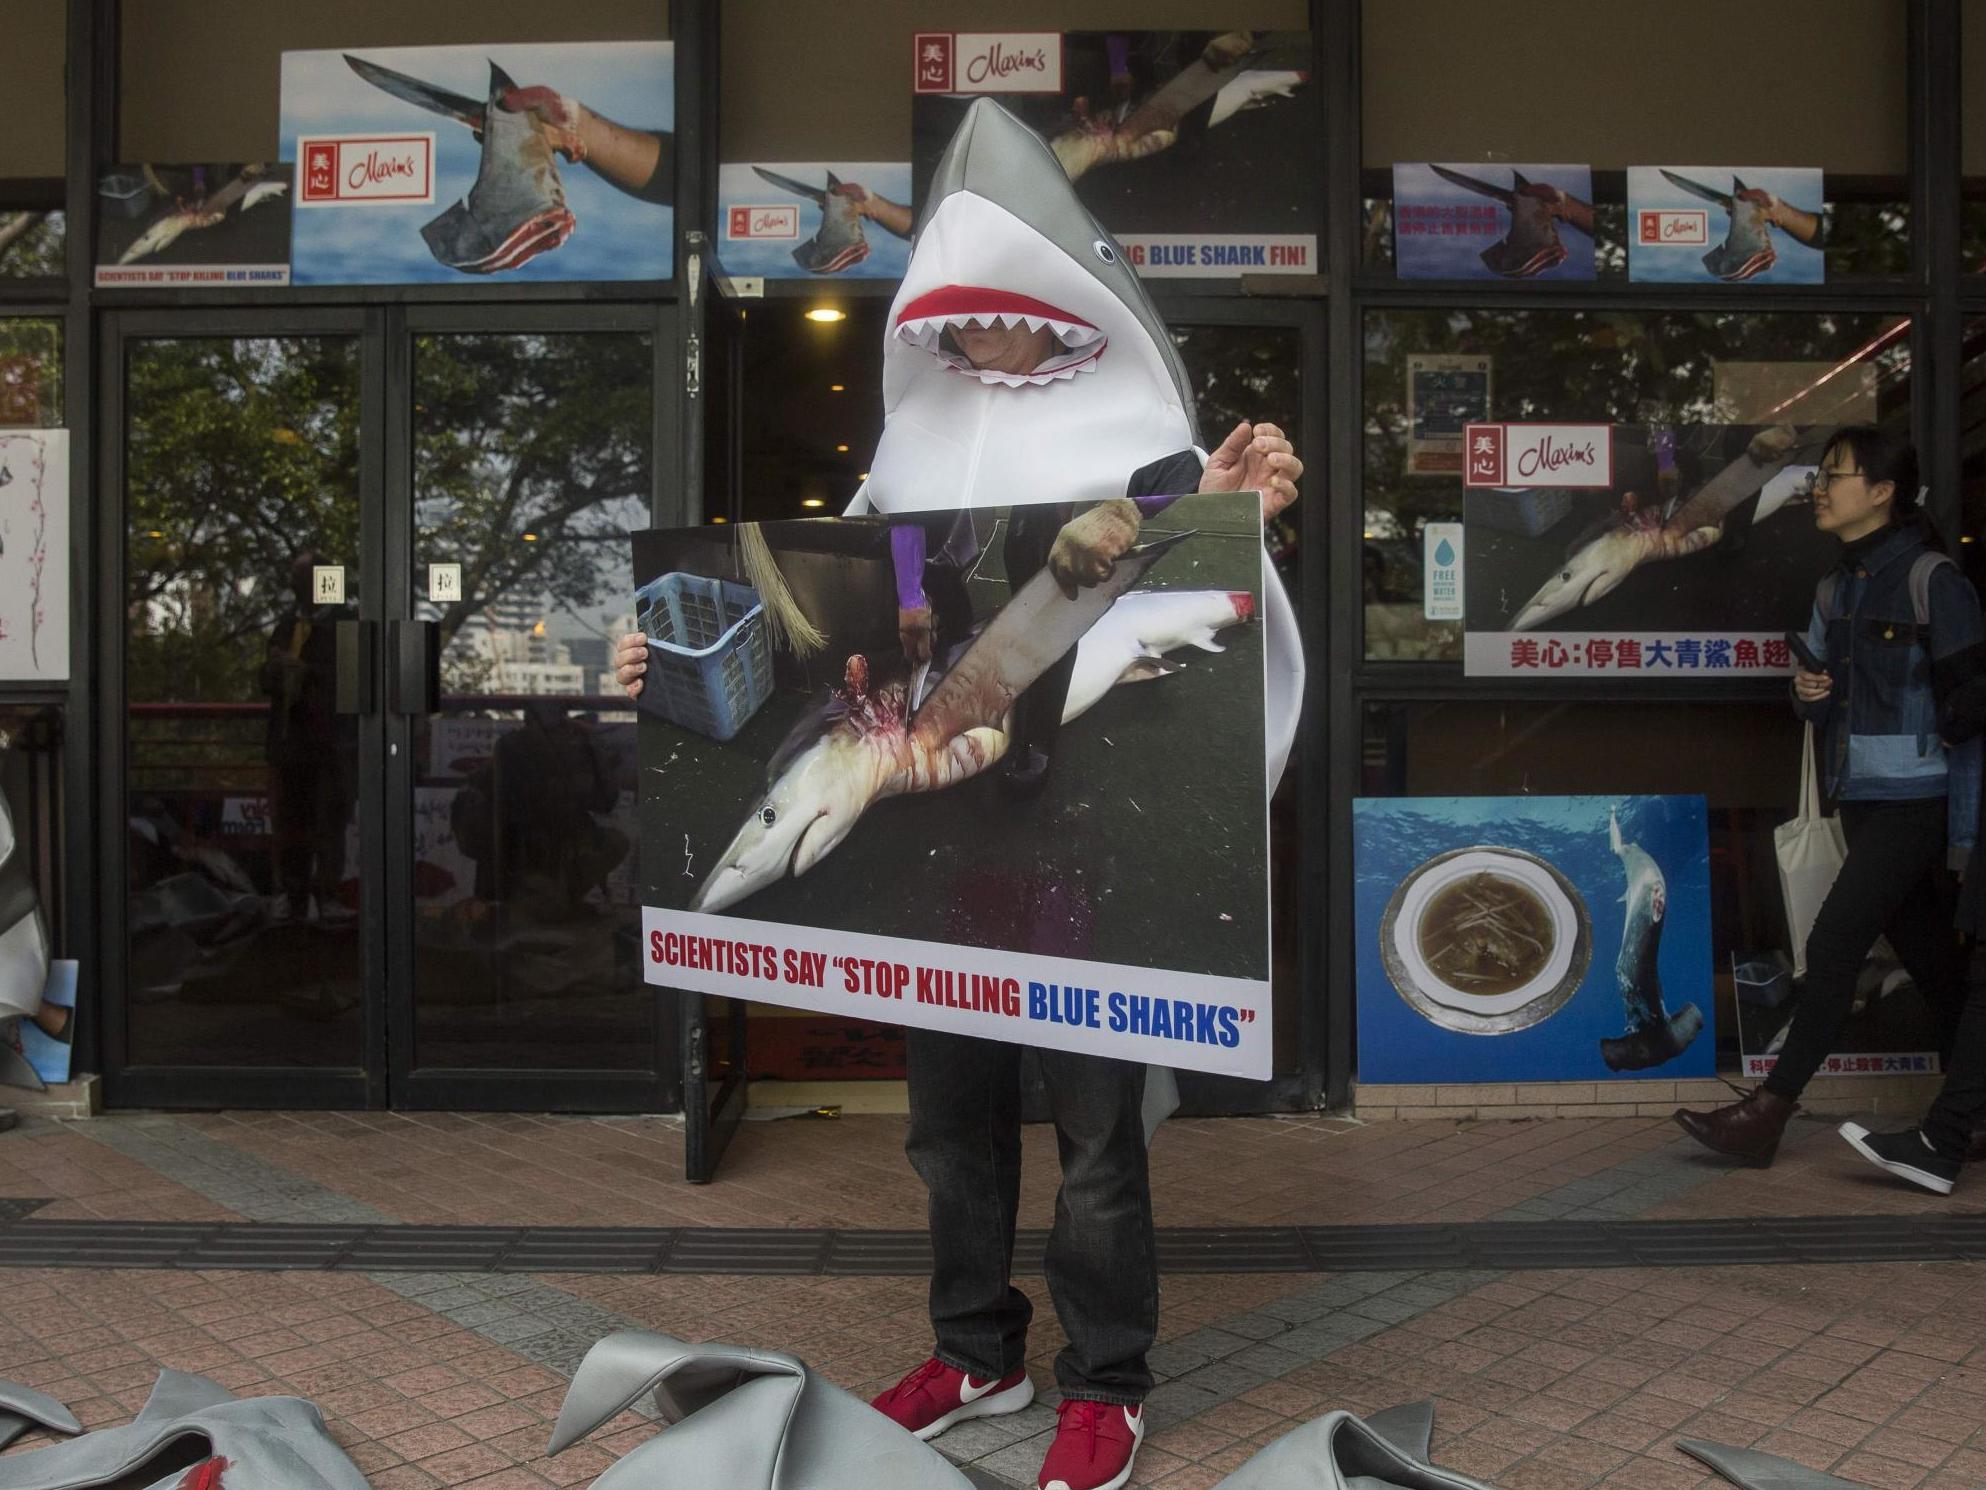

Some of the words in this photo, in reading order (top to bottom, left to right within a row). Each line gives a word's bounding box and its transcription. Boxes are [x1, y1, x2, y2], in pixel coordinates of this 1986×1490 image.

[922, 43, 945, 82] 美心
[967, 42, 1046, 84] Maxim's
[311, 152, 331, 190] 美心
[348, 151, 415, 190] Maxim's
[1150, 244, 1196, 266] BLUE
[1200, 244, 1266, 267] SHARK
[1270, 245, 1307, 267] FIN!
[1473, 436, 1496, 476] 美心
[1518, 435, 1597, 477] Maxim's
[321, 575, 337, 594] 拉
[1433, 569, 1456, 580] FREE
[650, 930, 778, 981] SCIENTISTS
[783, 948, 828, 988] SAY
[833, 955, 910, 1000] “STOP
[916, 966, 1021, 1018] KILLING
[1028, 981, 1100, 1029] BLUE
[1108, 991, 1256, 1049] SHARKS”
